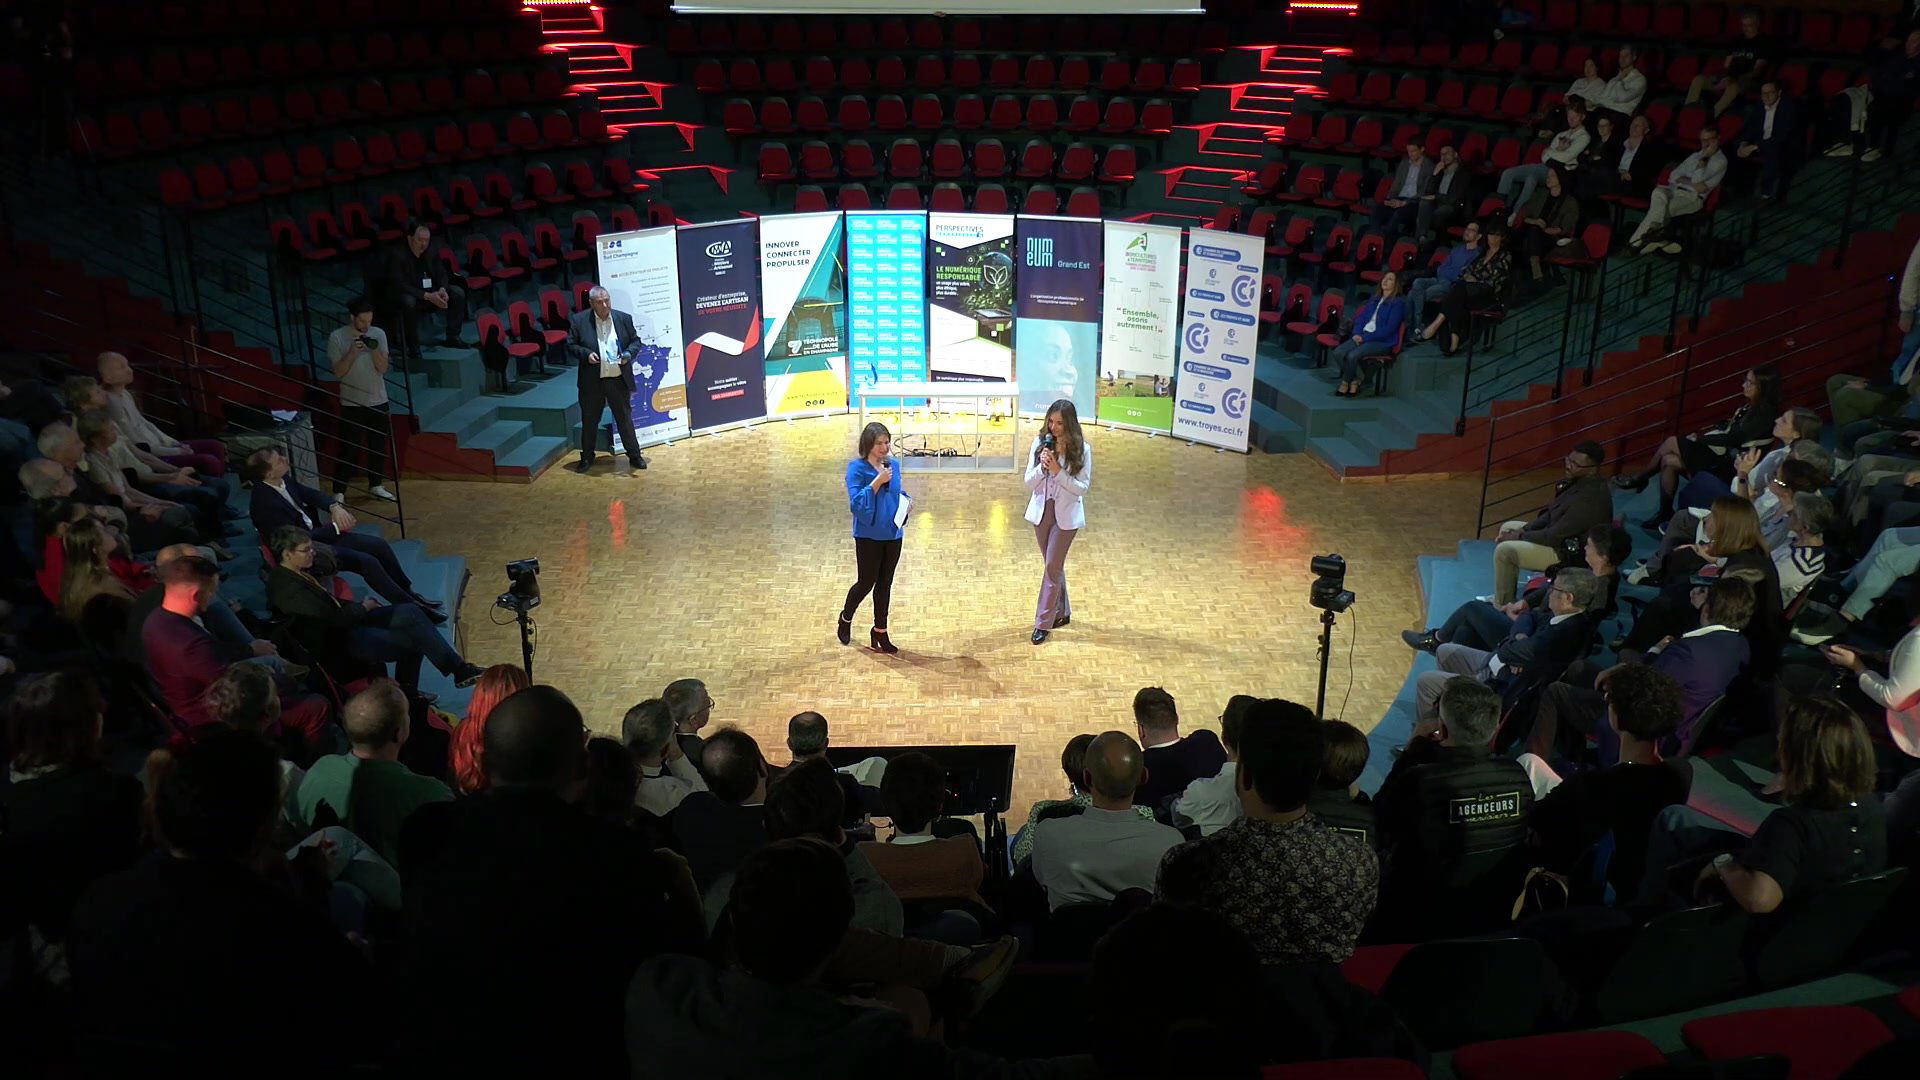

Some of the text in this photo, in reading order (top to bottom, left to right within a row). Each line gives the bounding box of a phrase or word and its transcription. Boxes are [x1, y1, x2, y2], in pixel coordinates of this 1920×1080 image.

[936, 224, 984, 232] PERSPECTIVES
[766, 240, 800, 248] INNOVER
[766, 250, 810, 258] CONNECTER
[766, 258, 810, 268] PROPULSER
[1058, 260, 1090, 270] Grand Est
[945, 265, 982, 274] NUMÉRIQUE
[696, 300, 721, 309] DEVENEZ
[1122, 308, 1159, 320] Ensemble,
[1117, 322, 1154, 331] autrement
[1178, 416, 1244, 437] www.troyes.cci.fr
[1459, 800, 1514, 816] AGENCEURS
